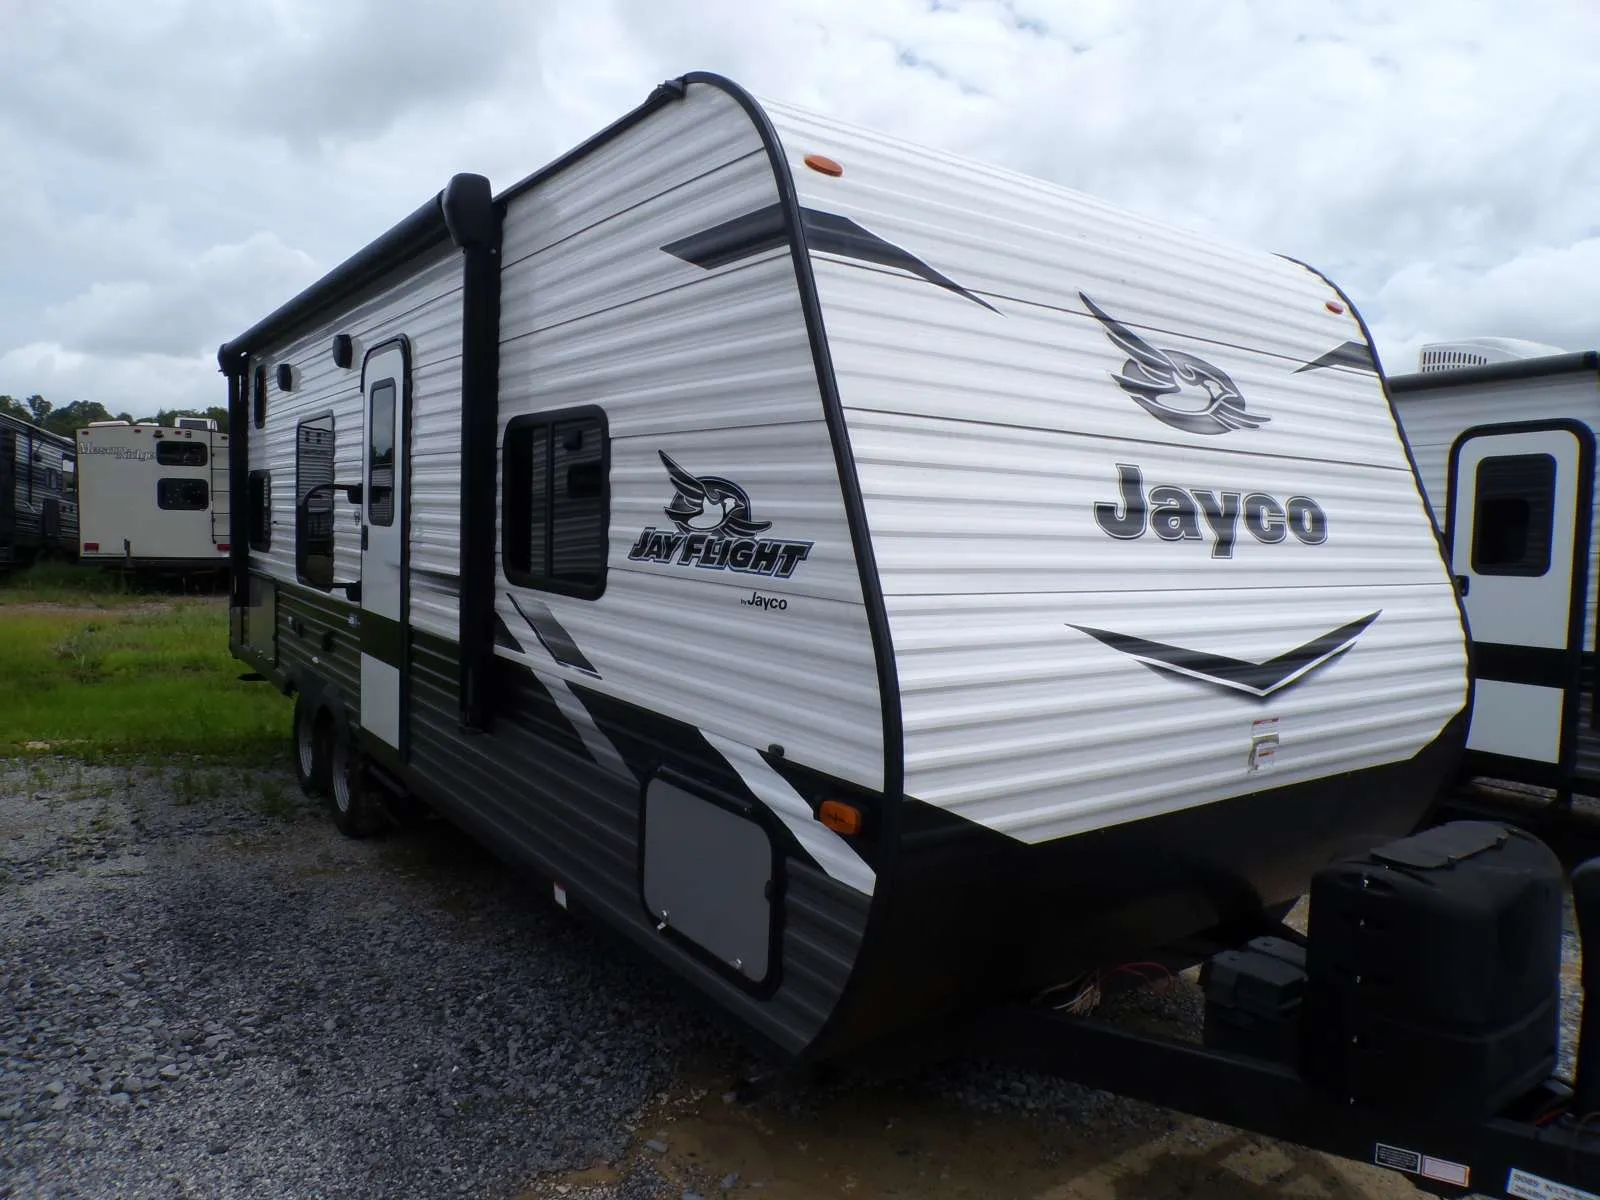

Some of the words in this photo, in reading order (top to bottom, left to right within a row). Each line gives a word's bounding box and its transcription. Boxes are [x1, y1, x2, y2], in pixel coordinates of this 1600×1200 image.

[1093, 463, 1328, 559] Jayco
[627, 527, 688, 564] JAY
[677, 532, 815, 579] FLIGHT
[747, 591, 788, 611] Jayco
